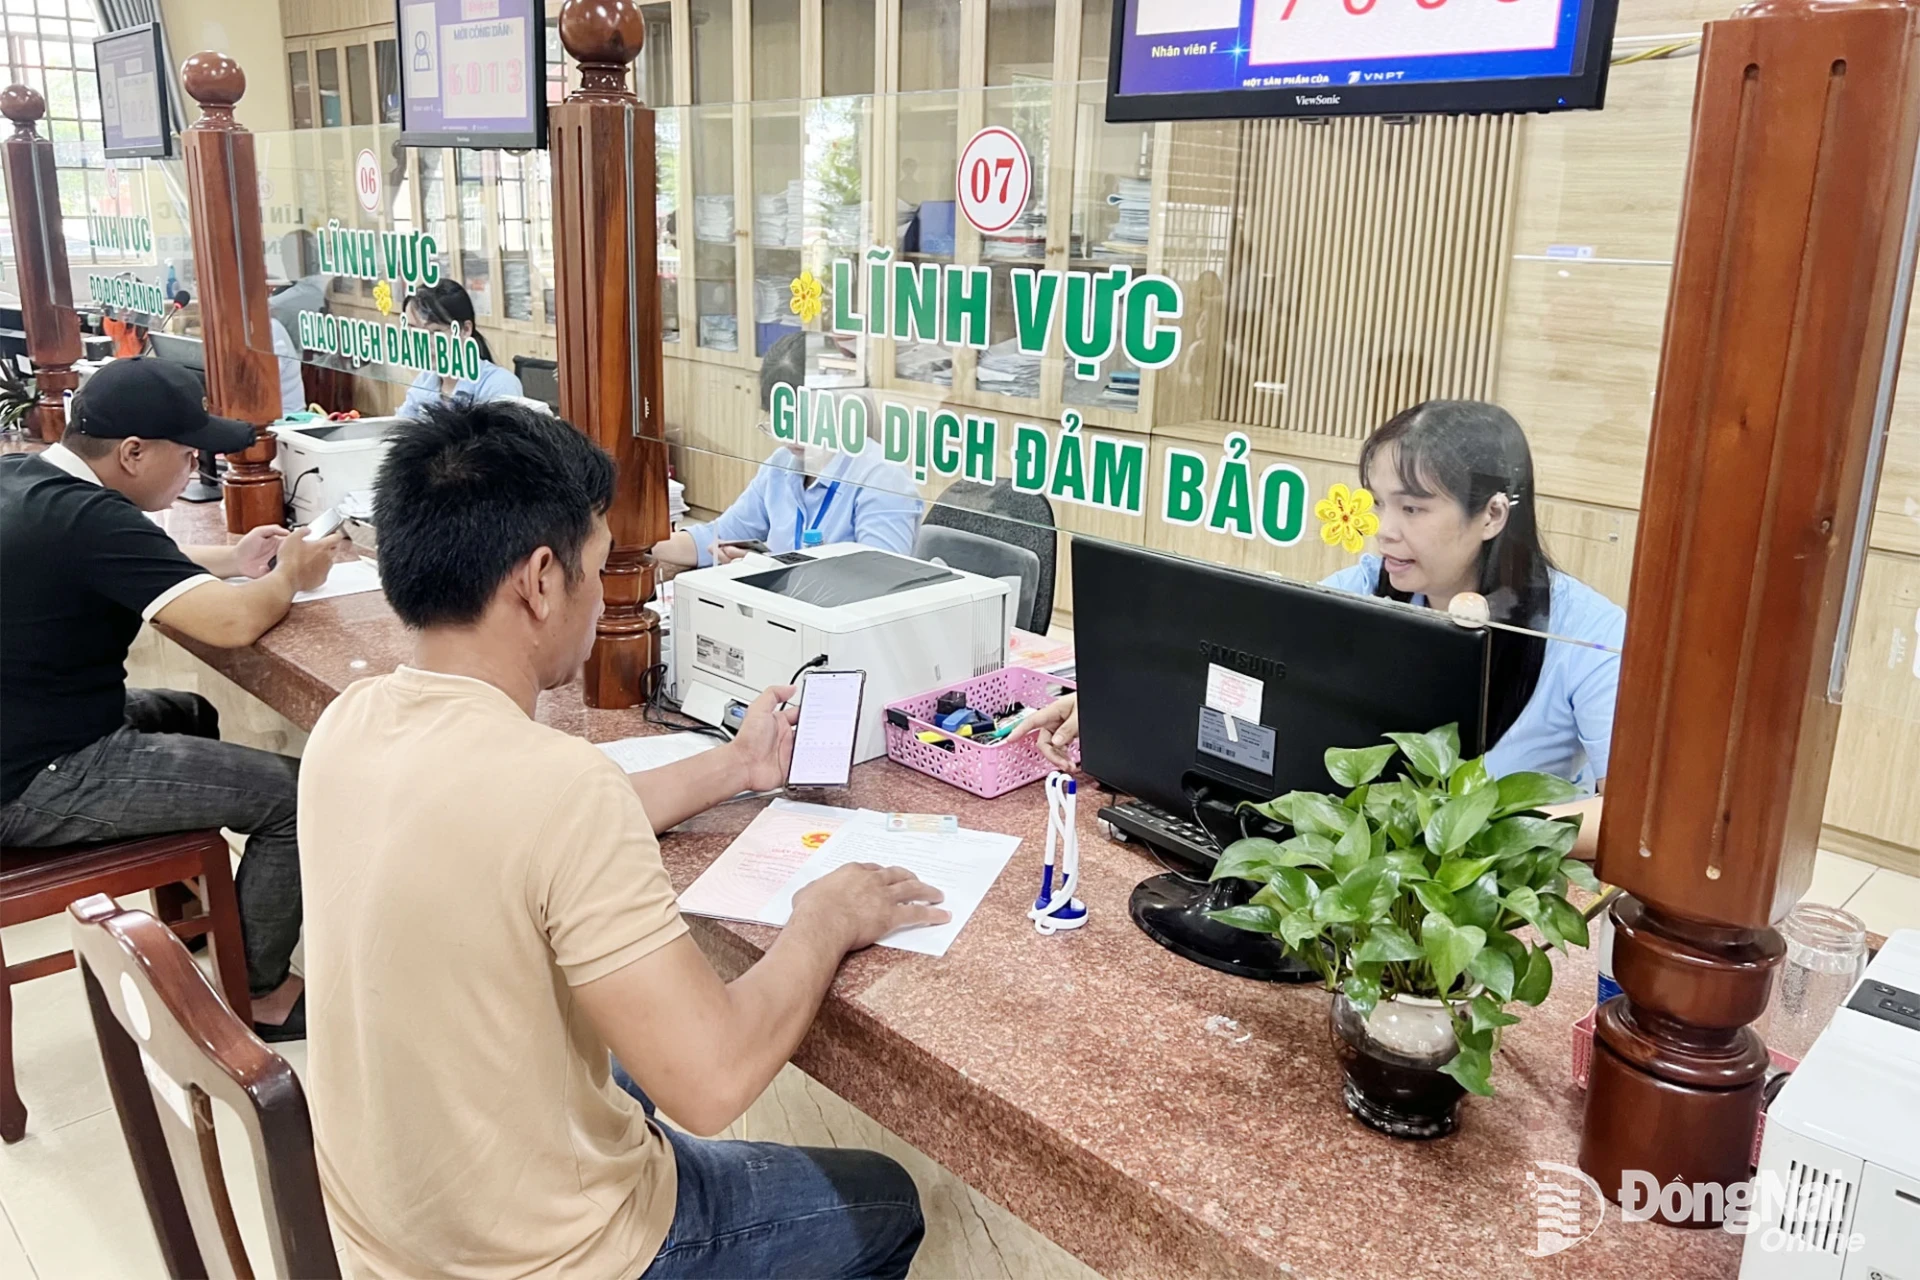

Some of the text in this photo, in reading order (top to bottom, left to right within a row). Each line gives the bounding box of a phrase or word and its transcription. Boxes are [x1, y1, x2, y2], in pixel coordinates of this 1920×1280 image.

[1151, 41, 1218, 58] Nhân viên F
[448, 58, 523, 95] 6013
[1363, 71, 1404, 81] VNPT
[1295, 94, 1341, 106] ViewSonic
[360, 167, 377, 194] 06
[970, 157, 1015, 205] 07
[87, 209, 119, 248] LĨNH
[121, 215, 151, 258] VỰC
[318, 221, 439, 293] LĨNH VỰC
[832, 248, 1179, 377] LĨNH VỰC
[300, 313, 480, 381] GIAO DỊCH ĐẢM BẢO
[772, 386, 1306, 543] GIAO DỊCH ĐẢM BẢO
[1200, 639, 1287, 680] SAMSUNG
